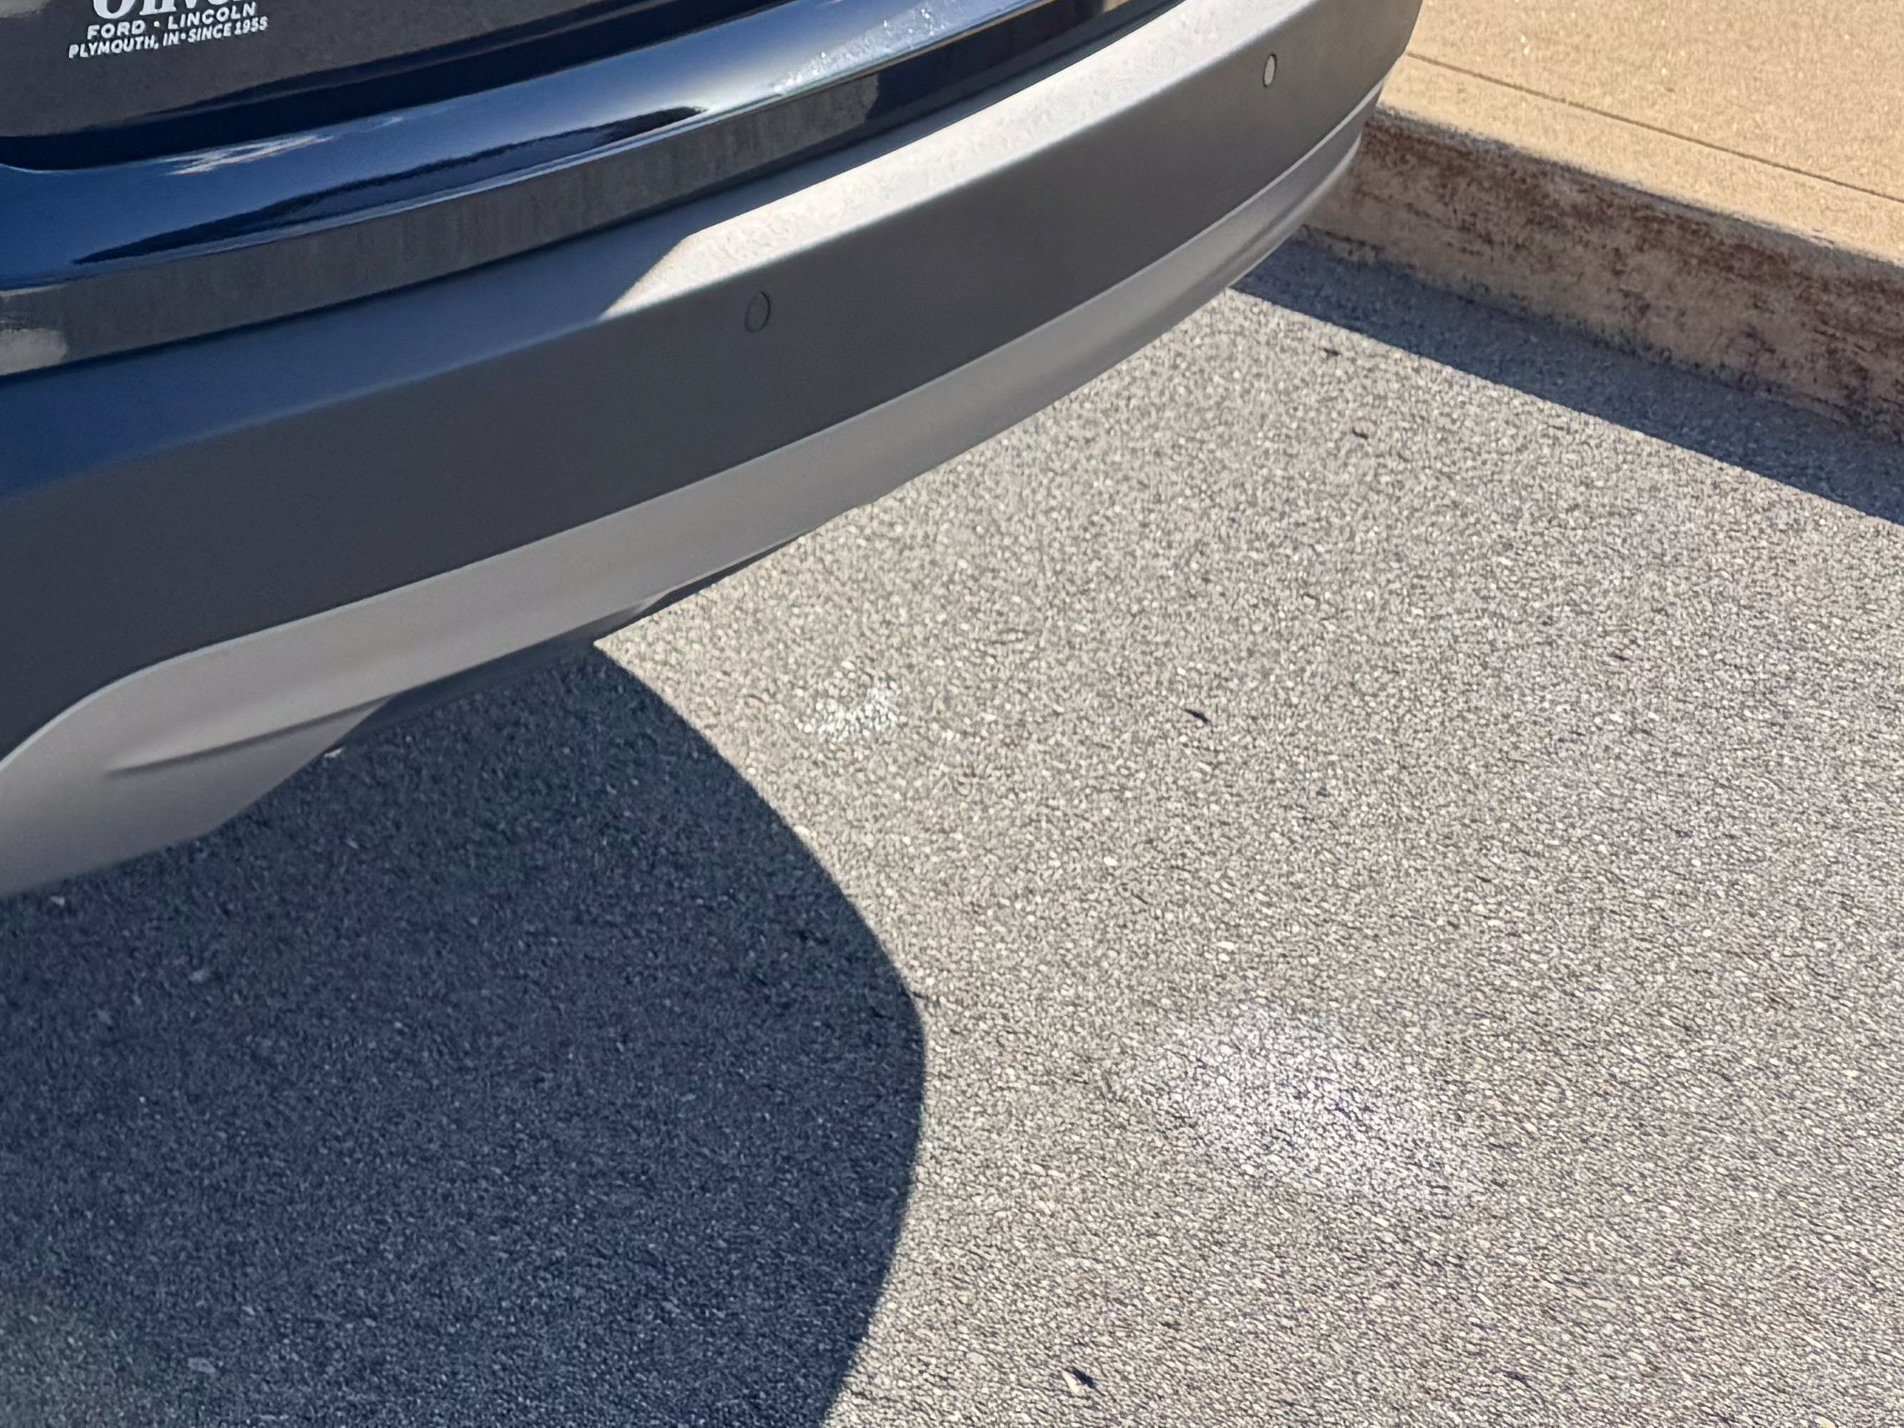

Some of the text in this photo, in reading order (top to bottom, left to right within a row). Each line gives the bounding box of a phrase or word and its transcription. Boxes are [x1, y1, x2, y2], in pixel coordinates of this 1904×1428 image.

[87, 1, 257, 40] FORD LINCOLN
[68, 34, 159, 58] PLYMOUTH,
